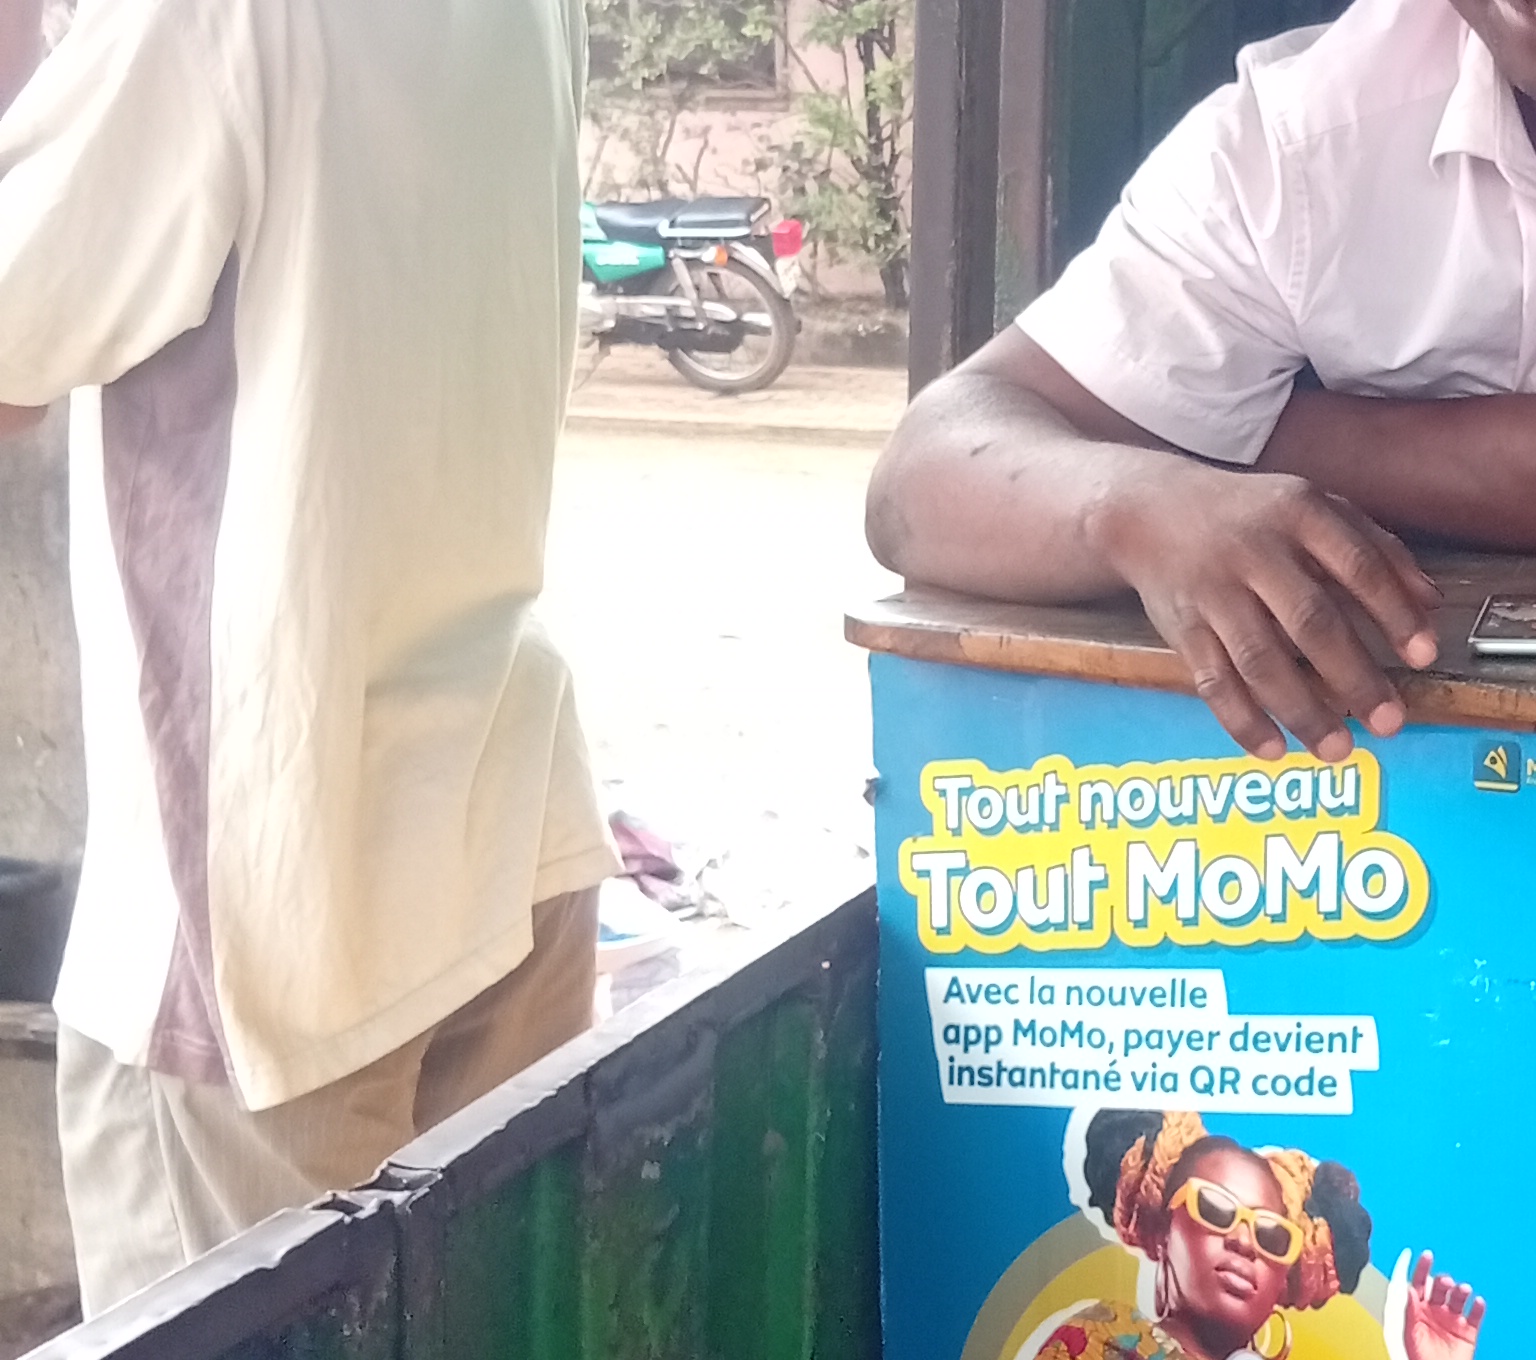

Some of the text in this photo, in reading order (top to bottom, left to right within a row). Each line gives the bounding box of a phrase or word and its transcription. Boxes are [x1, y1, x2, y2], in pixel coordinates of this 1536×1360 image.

[933, 763, 1359, 833] Tout nouveau
[911, 831, 1407, 934] Tout MoMo
[943, 976, 1208, 1008] Avec la nouvelle
[943, 1019, 1364, 1058] app MoMo, payer devient
[947, 1056, 1338, 1098] instantané via QR code
